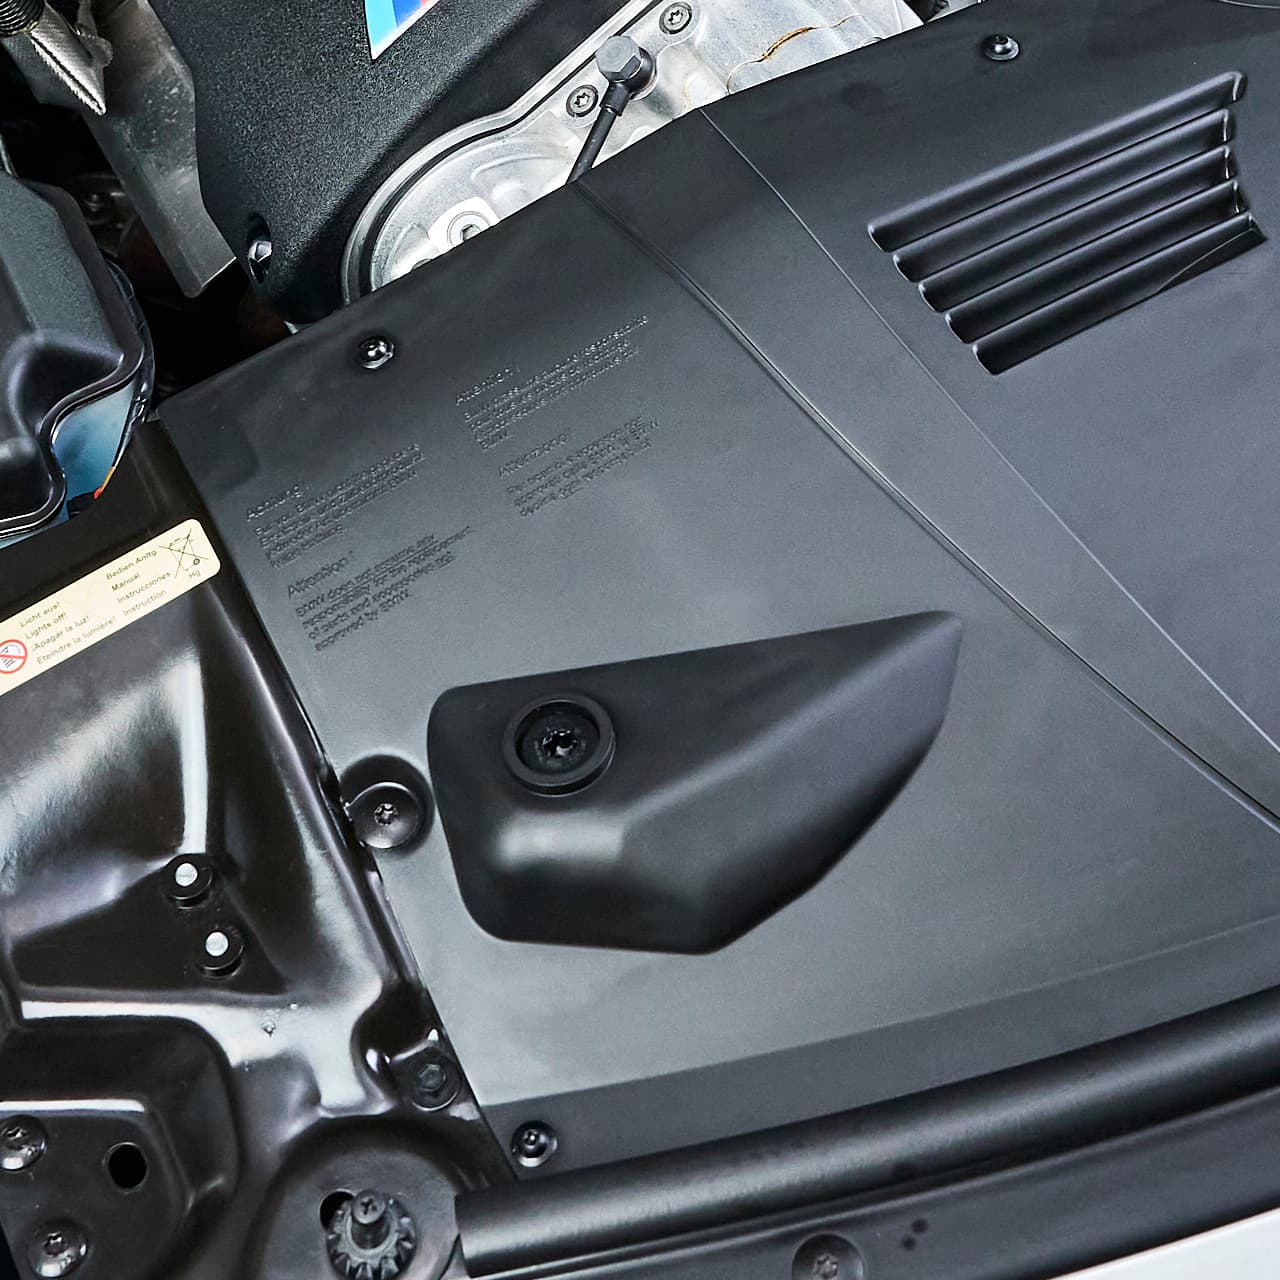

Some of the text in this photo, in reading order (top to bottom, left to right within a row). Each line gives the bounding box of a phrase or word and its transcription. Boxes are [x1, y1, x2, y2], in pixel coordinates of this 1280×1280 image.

[111, 573, 140, 592] Manual
[188, 569, 201, 579] Hg
[116, 572, 171, 603] Instrucciones
[123, 589, 167, 616] Instruction
[25, 622, 52, 640] Lights
